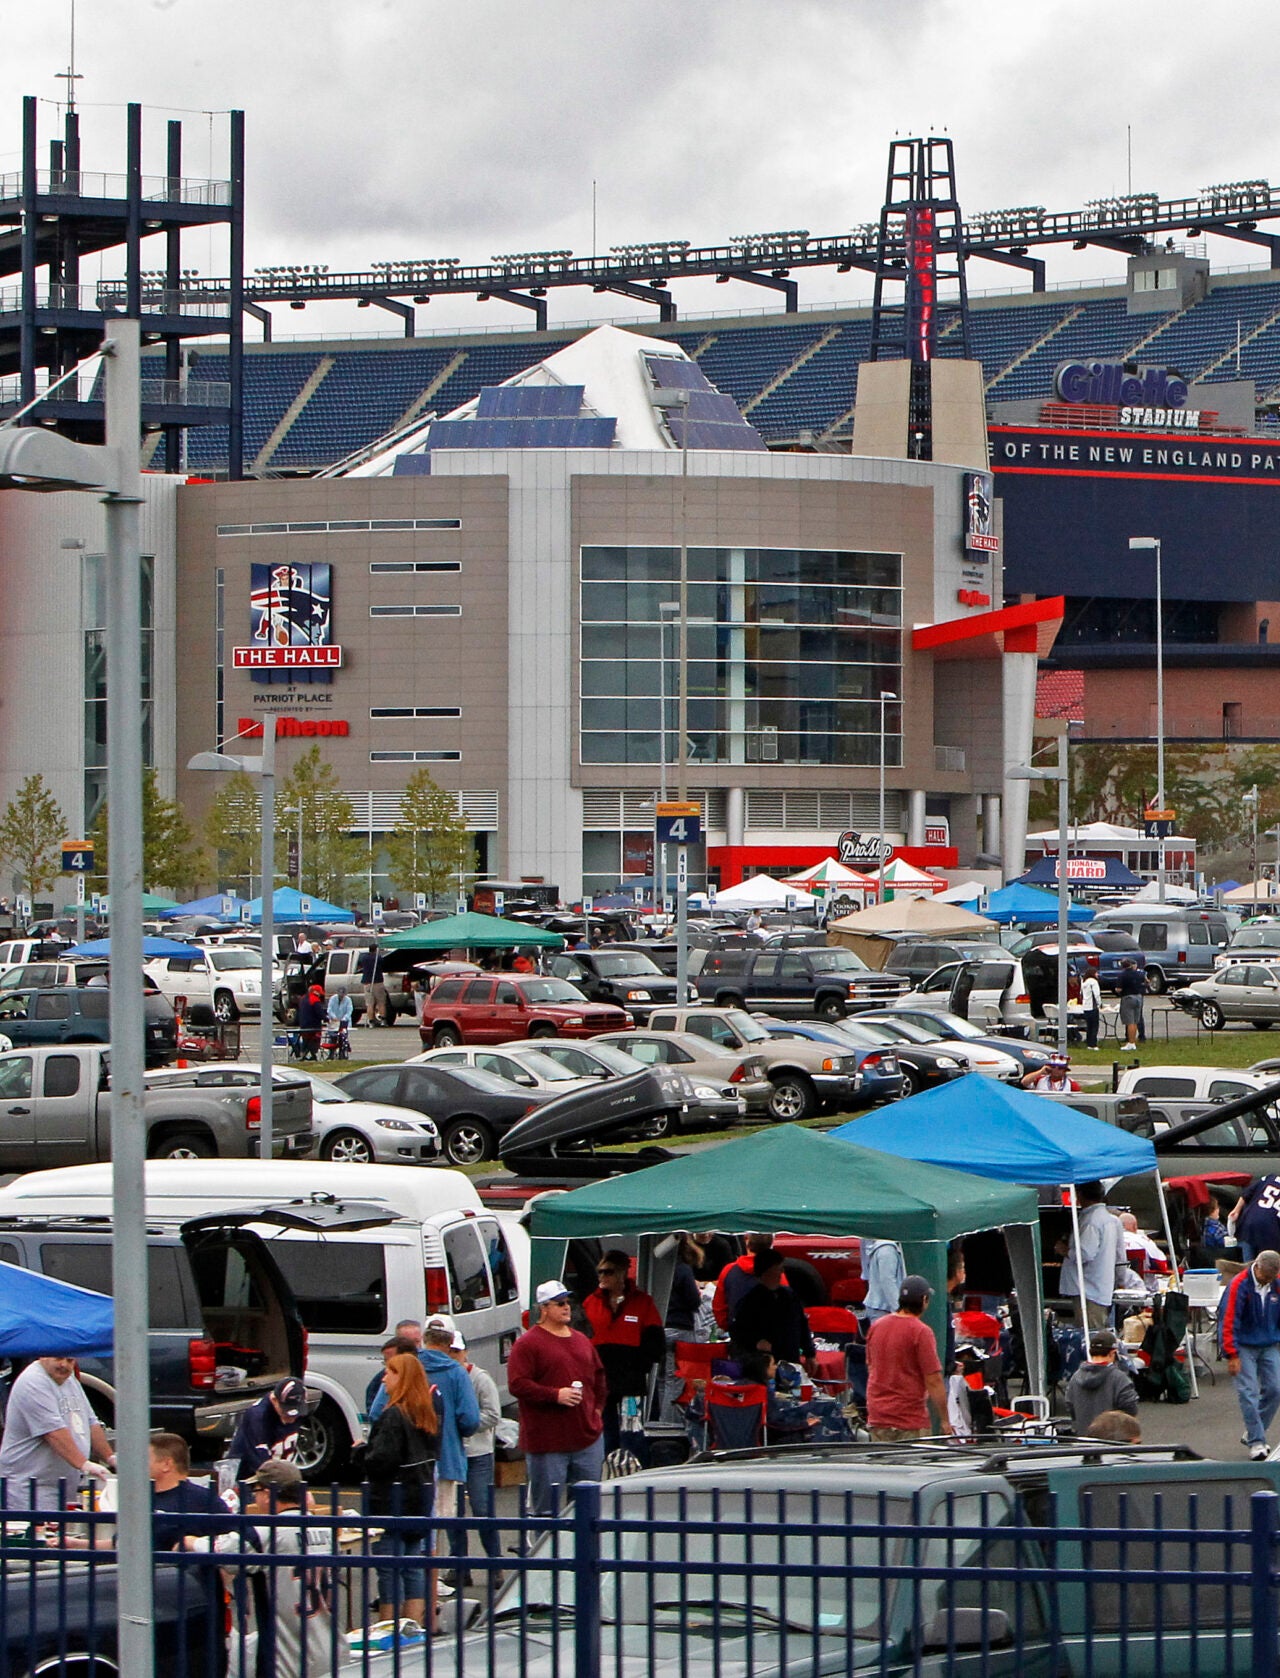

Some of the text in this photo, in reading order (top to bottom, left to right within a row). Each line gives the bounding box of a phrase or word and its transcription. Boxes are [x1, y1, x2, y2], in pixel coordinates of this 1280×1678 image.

[1057, 362, 1188, 408] Gillette
[1120, 407, 1200, 428] STADIUM
[1005, 442, 1032, 459] OF
[1039, 444, 1080, 461] THE
[1089, 446, 1133, 463] NEW
[1143, 449, 1242, 469] ENGLAND
[237, 649, 338, 664] THE HALL
[254, 693, 333, 703] PATRIOT PLACE
[669, 818, 688, 840] 4
[1150, 821, 1159, 836] 4
[71, 852, 85, 869] 4
